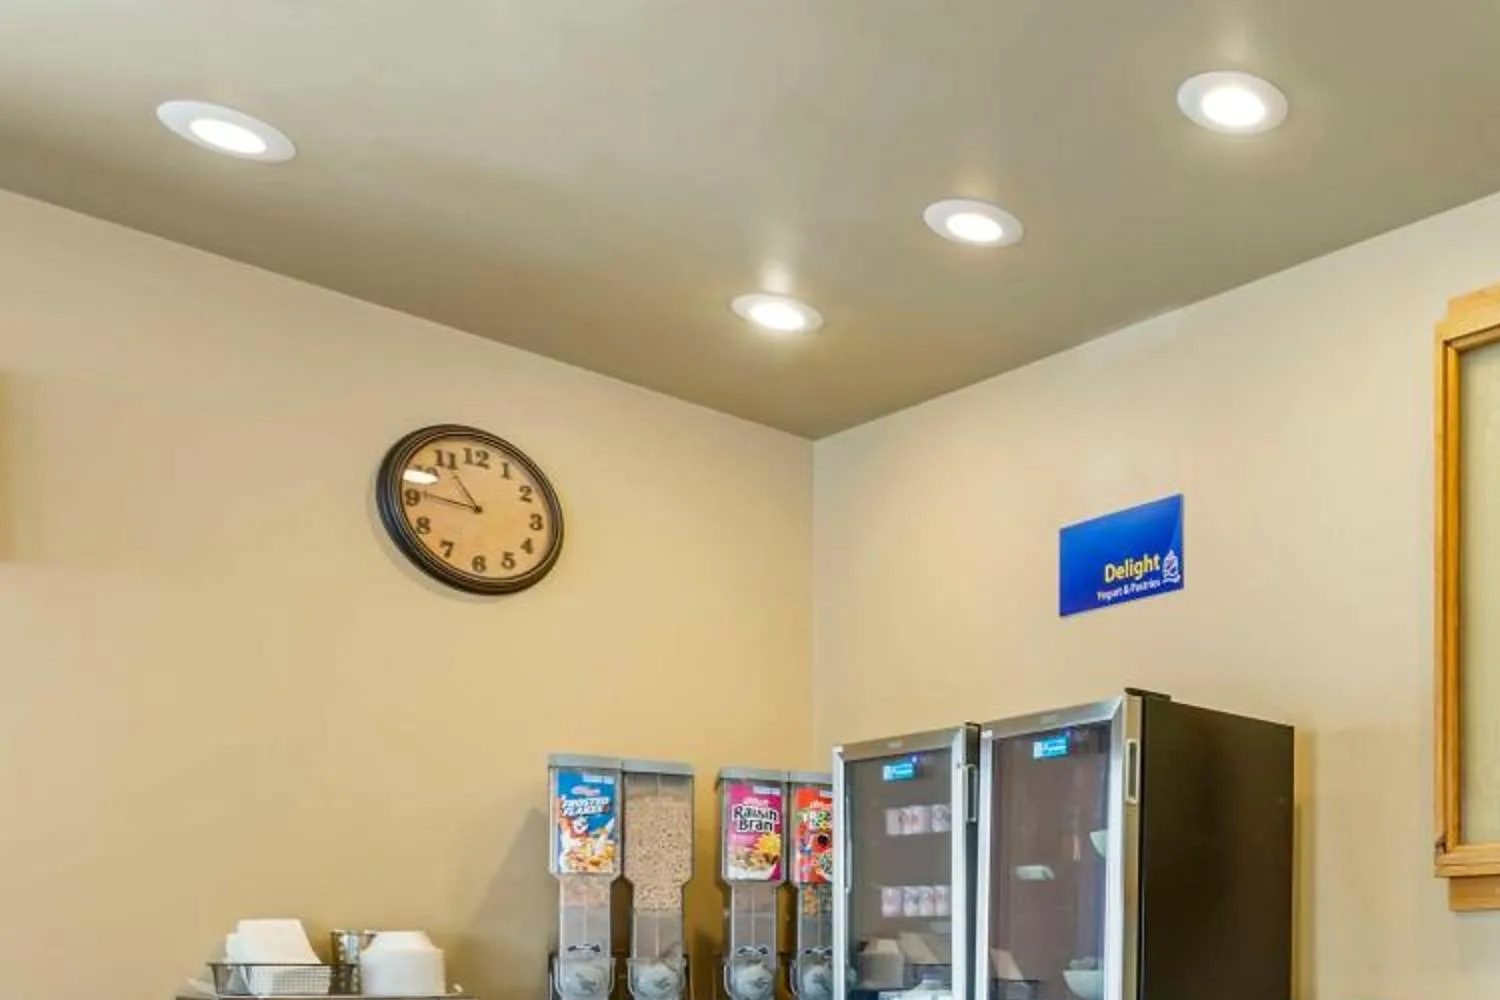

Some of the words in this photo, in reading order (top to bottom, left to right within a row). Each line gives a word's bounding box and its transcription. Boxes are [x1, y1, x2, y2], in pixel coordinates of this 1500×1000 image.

[435, 449, 458, 470] 11
[463, 447, 490, 469] 12
[502, 462, 512, 479] 1
[405, 488, 420, 507] 9
[519, 485, 532, 503] 2
[416, 517, 431, 534] 8
[529, 513, 543, 531] 3
[440, 540, 454, 558] 7
[521, 538, 533, 554] 4
[472, 555, 486, 572] 6
[501, 552, 515, 569] 5
[1104, 553, 1160, 583] Delight
[733, 805, 778, 821] Raisin
[739, 819, 774, 832] Bran
